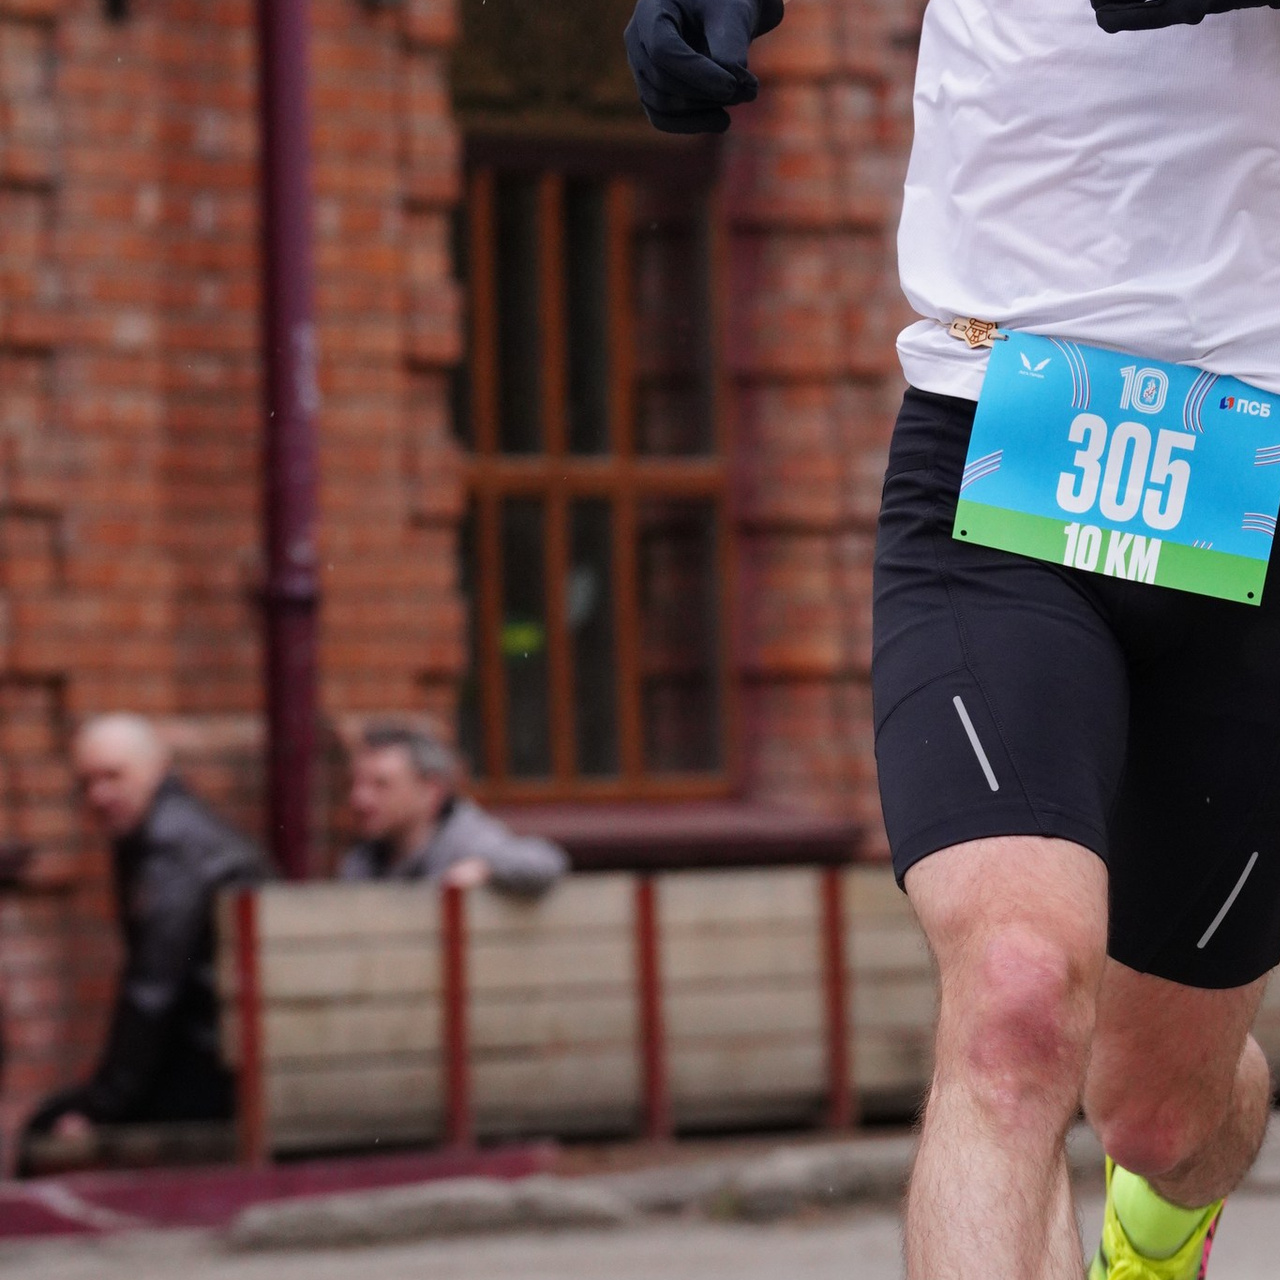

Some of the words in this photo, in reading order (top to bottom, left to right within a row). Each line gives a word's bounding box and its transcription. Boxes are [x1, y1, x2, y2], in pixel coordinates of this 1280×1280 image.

[1119, 365, 1169, 415] 10
[1236, 398, 1272, 418] ПСБ
[1056, 413, 1197, 531] 305
[1062, 521, 1103, 572] 10
